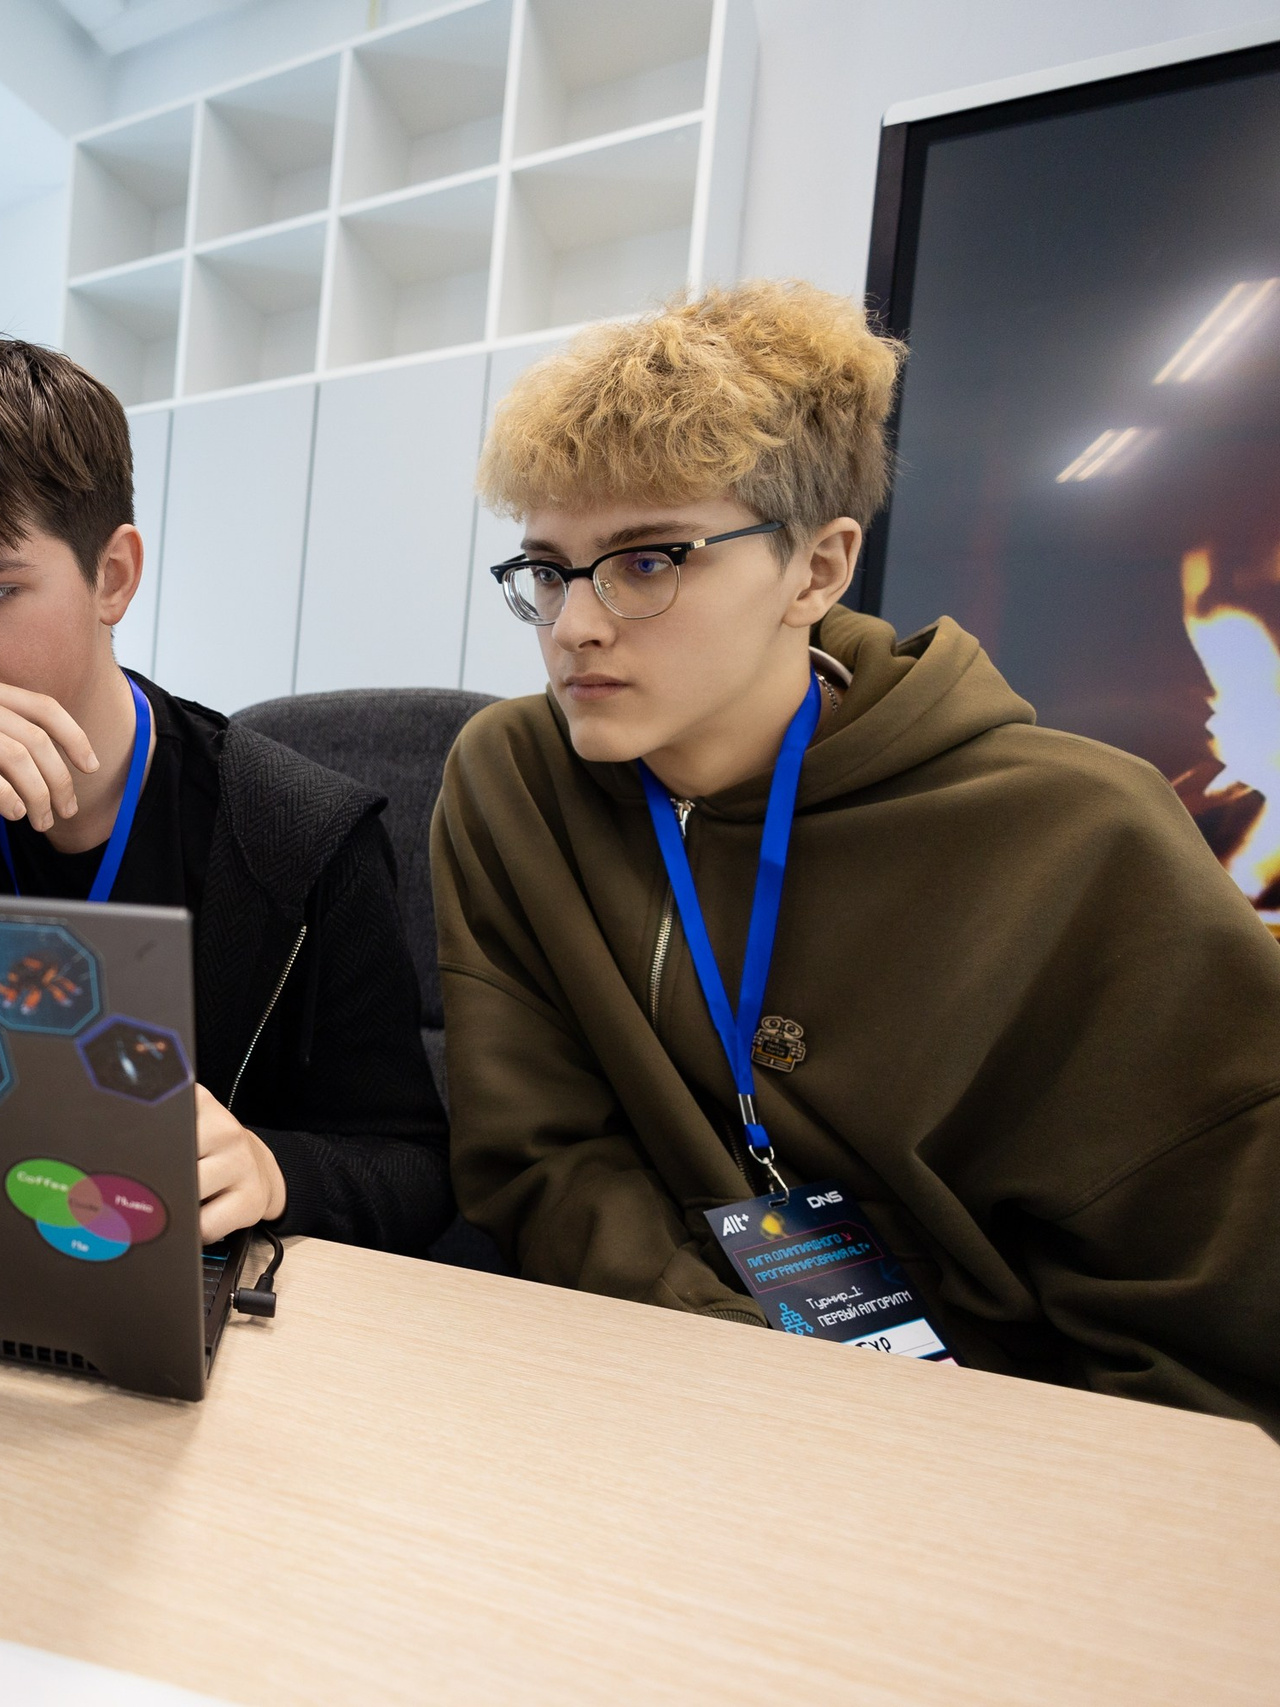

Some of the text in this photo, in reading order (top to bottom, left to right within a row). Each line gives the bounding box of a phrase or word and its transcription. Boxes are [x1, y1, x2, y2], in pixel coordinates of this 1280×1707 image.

[17, 1170, 69, 1192] Coffee
[806, 1190, 843, 1209] DNS
[722, 1213, 750, 1236] Alt+
[746, 1233, 842, 1269] ЛИГА ОЛИМПИАДНОГО
[755, 1250, 849, 1283] ПРОГРАММИРОВАНИЯ
[817, 1290, 913, 1328] ПЕРВЫЙ АЛГОРИТМ
